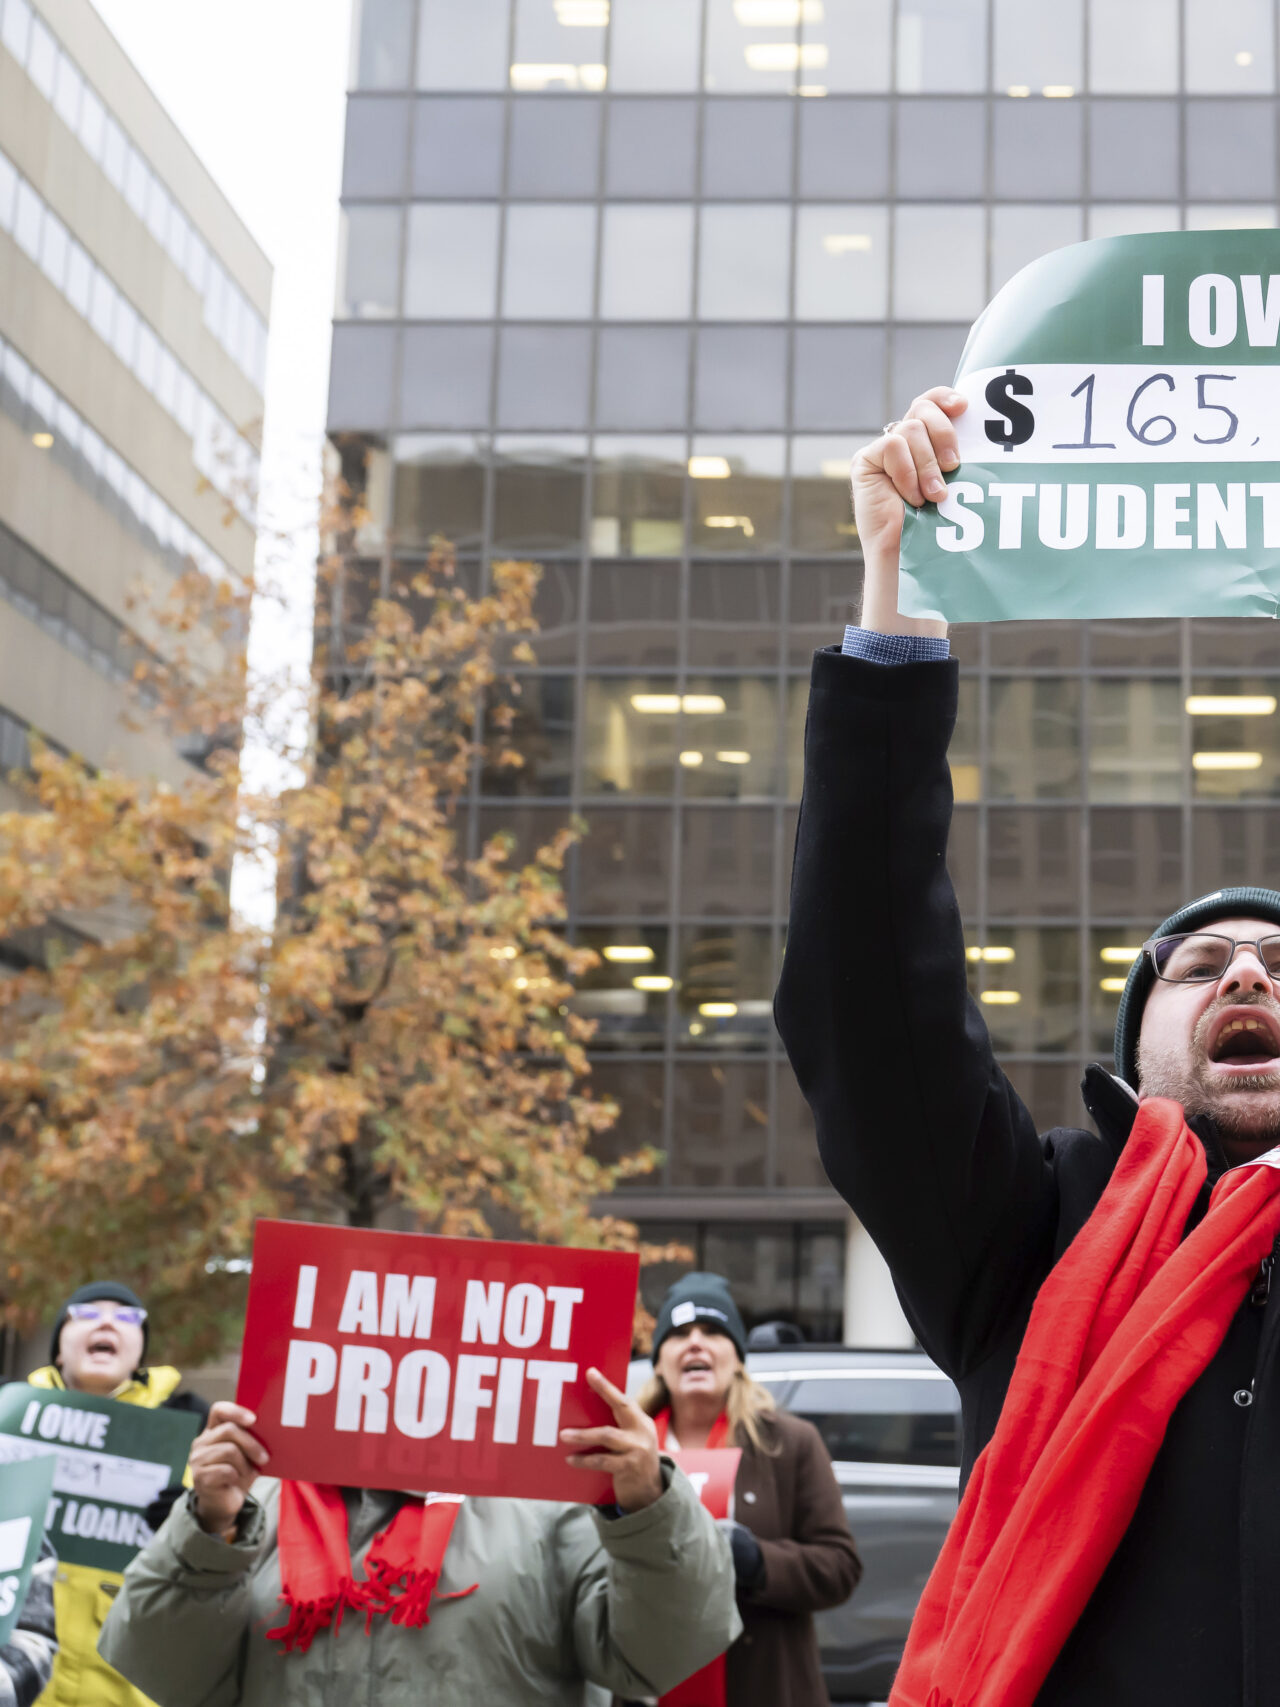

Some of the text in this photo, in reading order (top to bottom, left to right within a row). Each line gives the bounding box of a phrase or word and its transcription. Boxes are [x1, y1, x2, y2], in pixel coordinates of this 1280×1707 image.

[1143, 274, 1165, 346] I
[984, 369, 1036, 453] $
[293, 1265, 584, 1351] I AM NOT
[20, 1401, 111, 1449] I OWE
[281, 1340, 579, 1447] PROFIT
